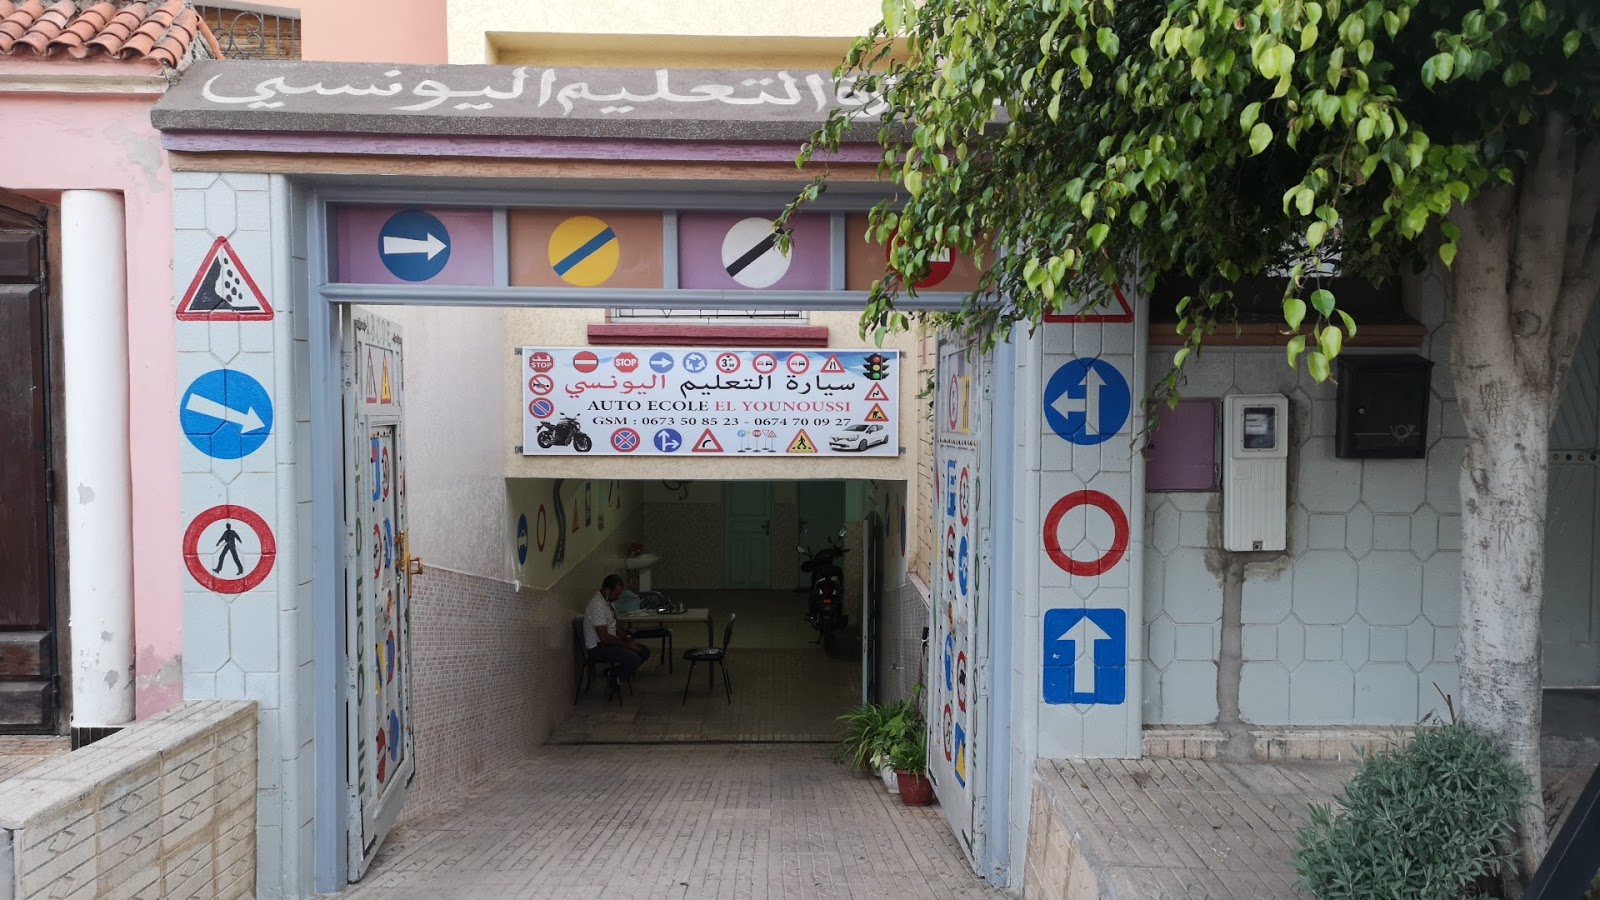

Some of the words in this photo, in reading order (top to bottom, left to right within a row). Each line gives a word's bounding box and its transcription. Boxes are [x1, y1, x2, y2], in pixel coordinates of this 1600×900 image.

[201, 67, 557, 111] اليونسي
[556, 69, 827, 117] التعليم
[532, 353, 551, 361] قف
[615, 358, 637, 367] STOP
[565, 374, 666, 398] اليونسي
[680, 374, 772, 398] التعليم
[786, 374, 856, 397] سيارة
[587, 400, 641, 411] AUTO
[648, 400, 709, 411] ECOLE
[715, 401, 736, 412] EL
[742, 401, 851, 412] YOUNOUSSI
[592, 416, 628, 426] GSM
[642, 416, 676, 426] 0673
[680, 417, 697, 426] 50
[701, 417, 718, 426] 85
[723, 417, 740, 426] 23
[754, 417, 788, 426] 0674
[793, 417, 810, 426] 70
[813, 417, 830, 427] 09
[835, 418, 852, 427] 27
